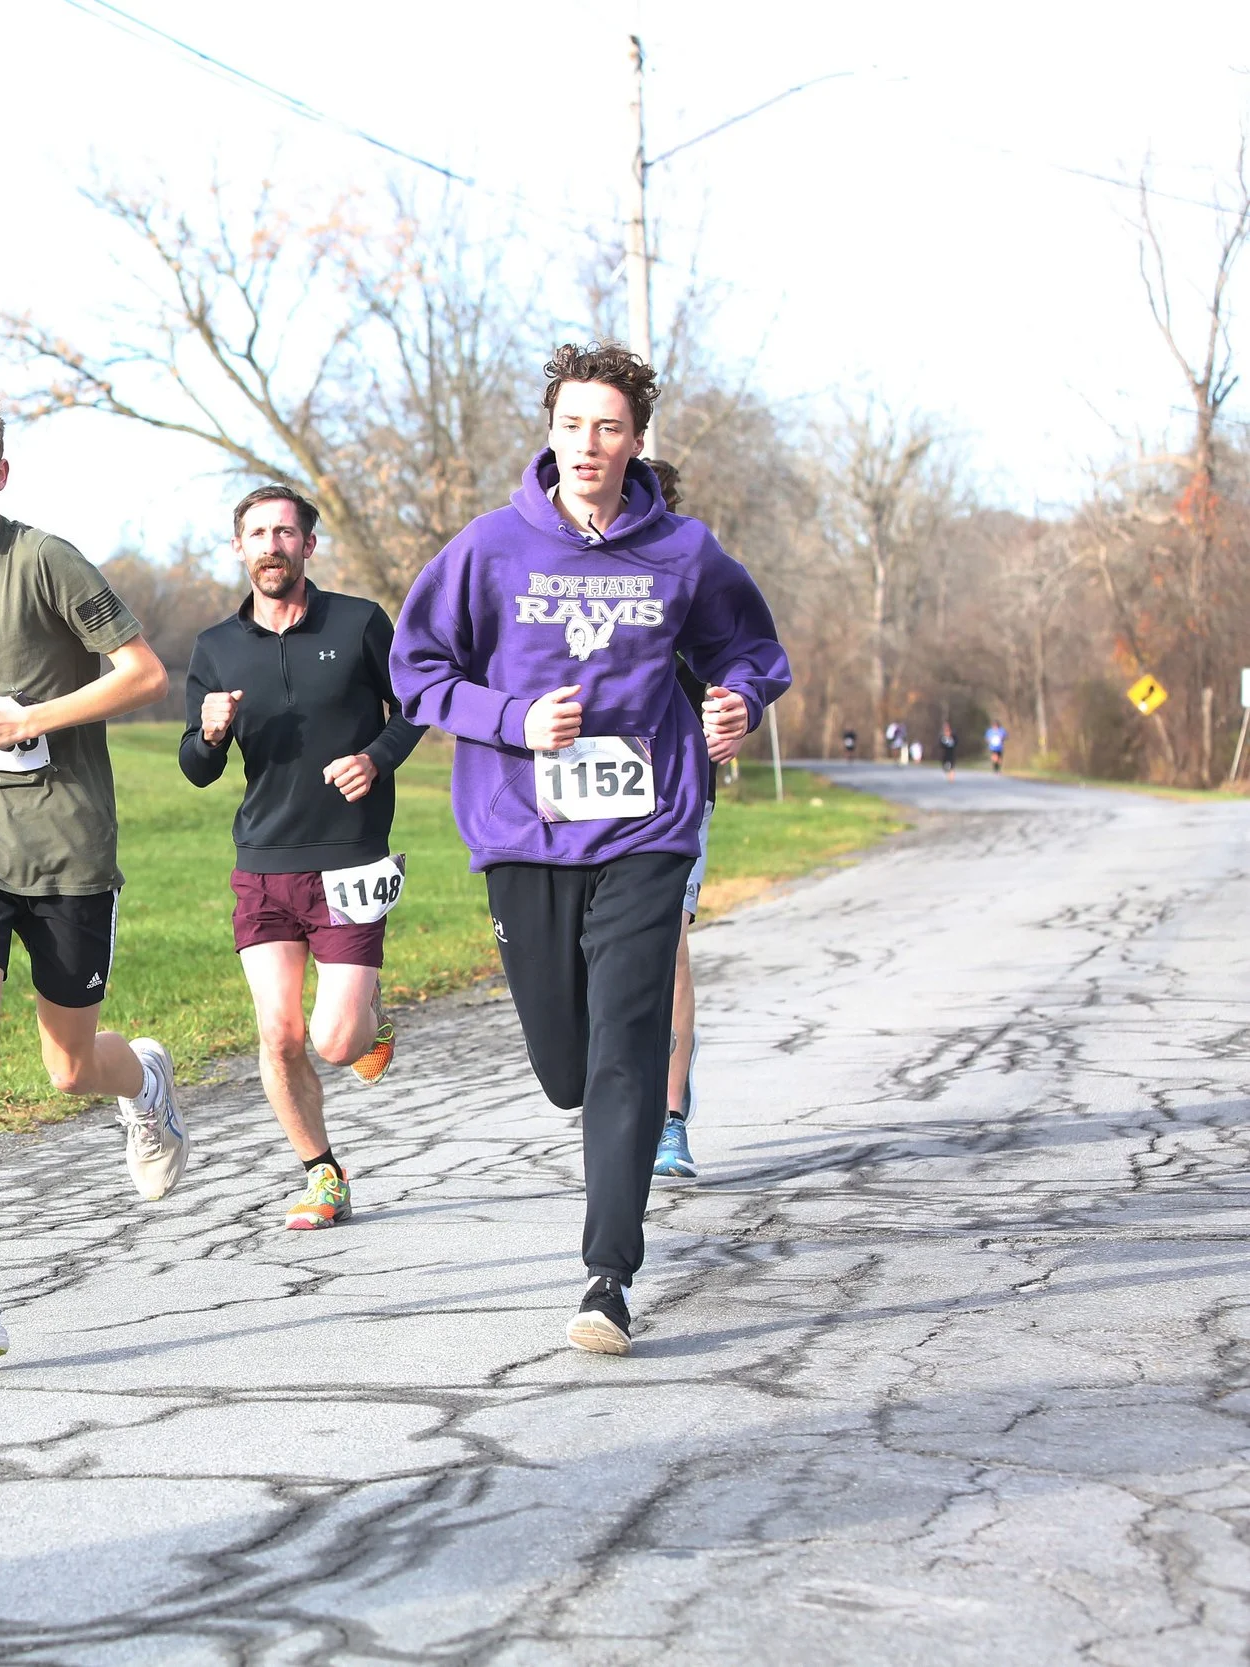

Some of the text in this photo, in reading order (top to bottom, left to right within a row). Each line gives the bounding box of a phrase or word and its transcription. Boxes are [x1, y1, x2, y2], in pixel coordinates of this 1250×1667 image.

[528, 572, 653, 598] ROY-HART
[515, 596, 664, 627] RAMS
[545, 761, 645, 800] 1152
[333, 875, 401, 907] 1148
